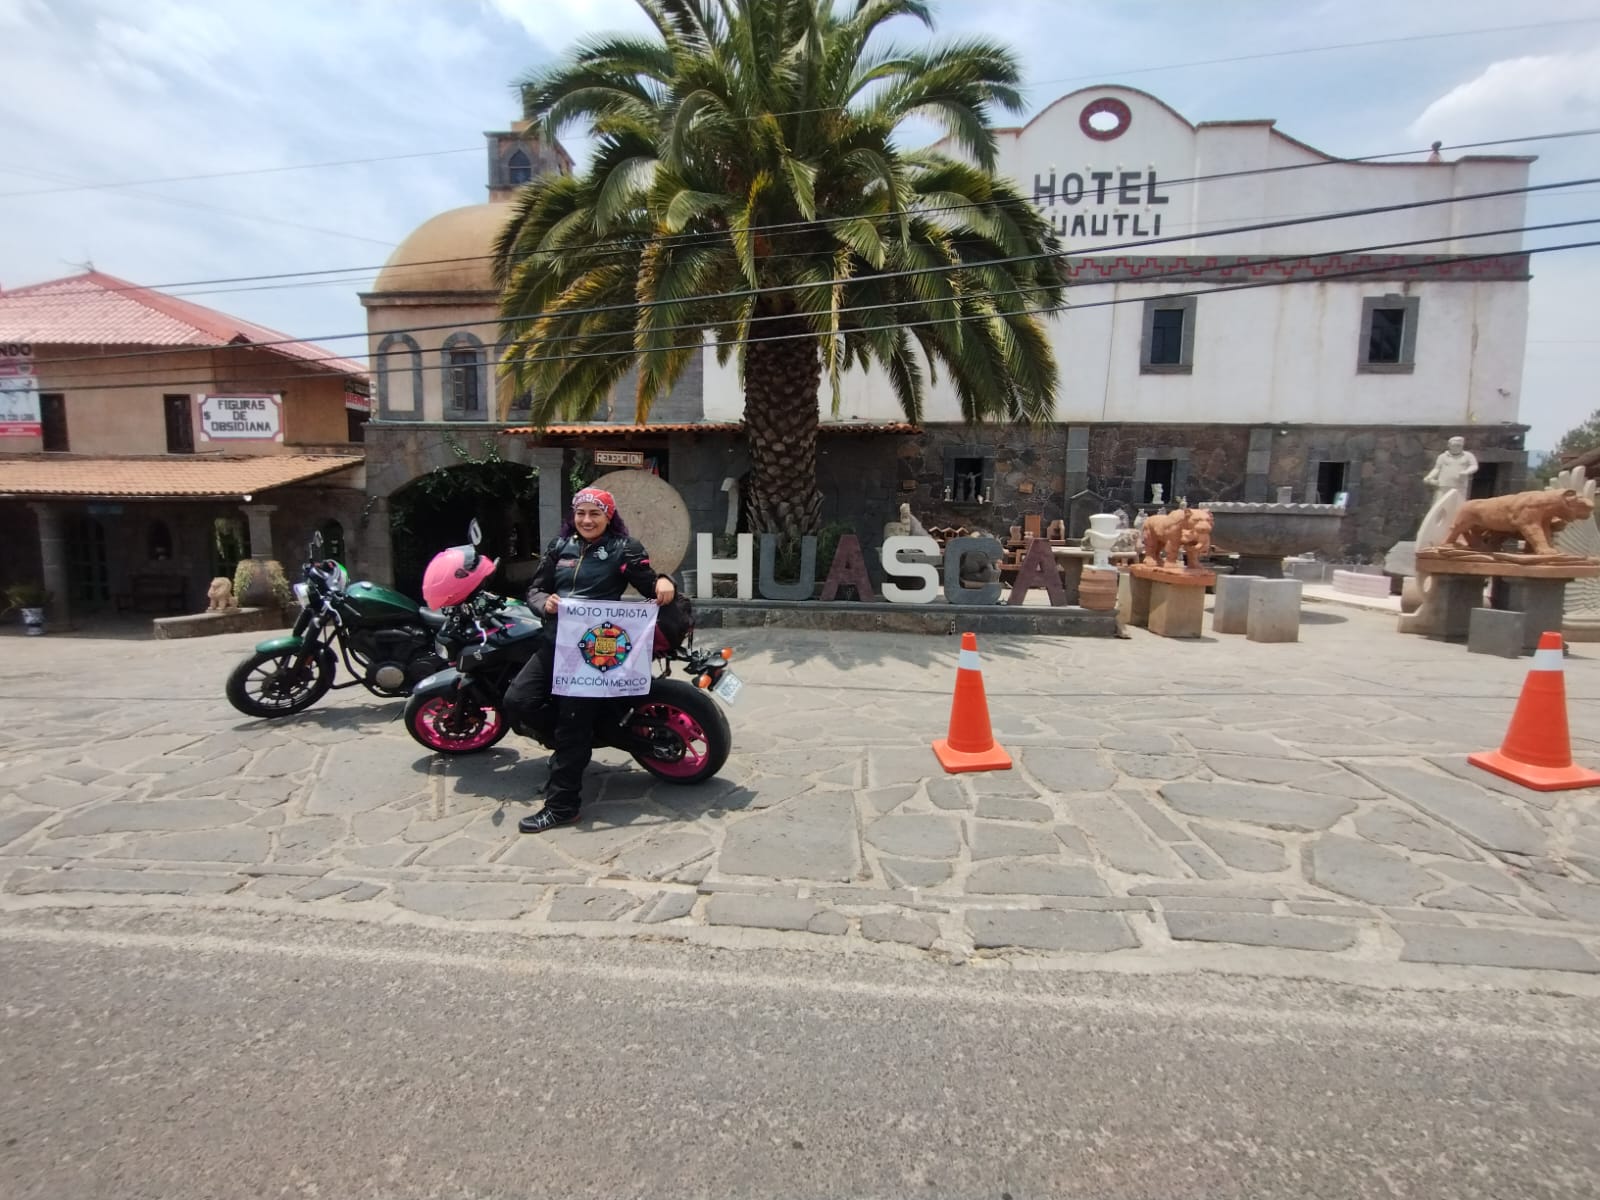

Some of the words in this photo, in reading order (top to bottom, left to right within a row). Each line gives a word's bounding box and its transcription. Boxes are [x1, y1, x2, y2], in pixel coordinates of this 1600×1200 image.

[1034, 171, 1169, 206] HOTEL
[1042, 211, 1161, 237] UAUTLI
[217, 399, 266, 410] FIGURAS
[232, 411, 248, 421] DE
[210, 421, 272, 432] OBSIDIANA
[696, 532, 1068, 606] HUASCA
[566, 606, 602, 617] MOTO
[605, 608, 648, 618] TURISTA
[555, 676, 569, 685] EN
[570, 675, 609, 687] ACCIÓN
